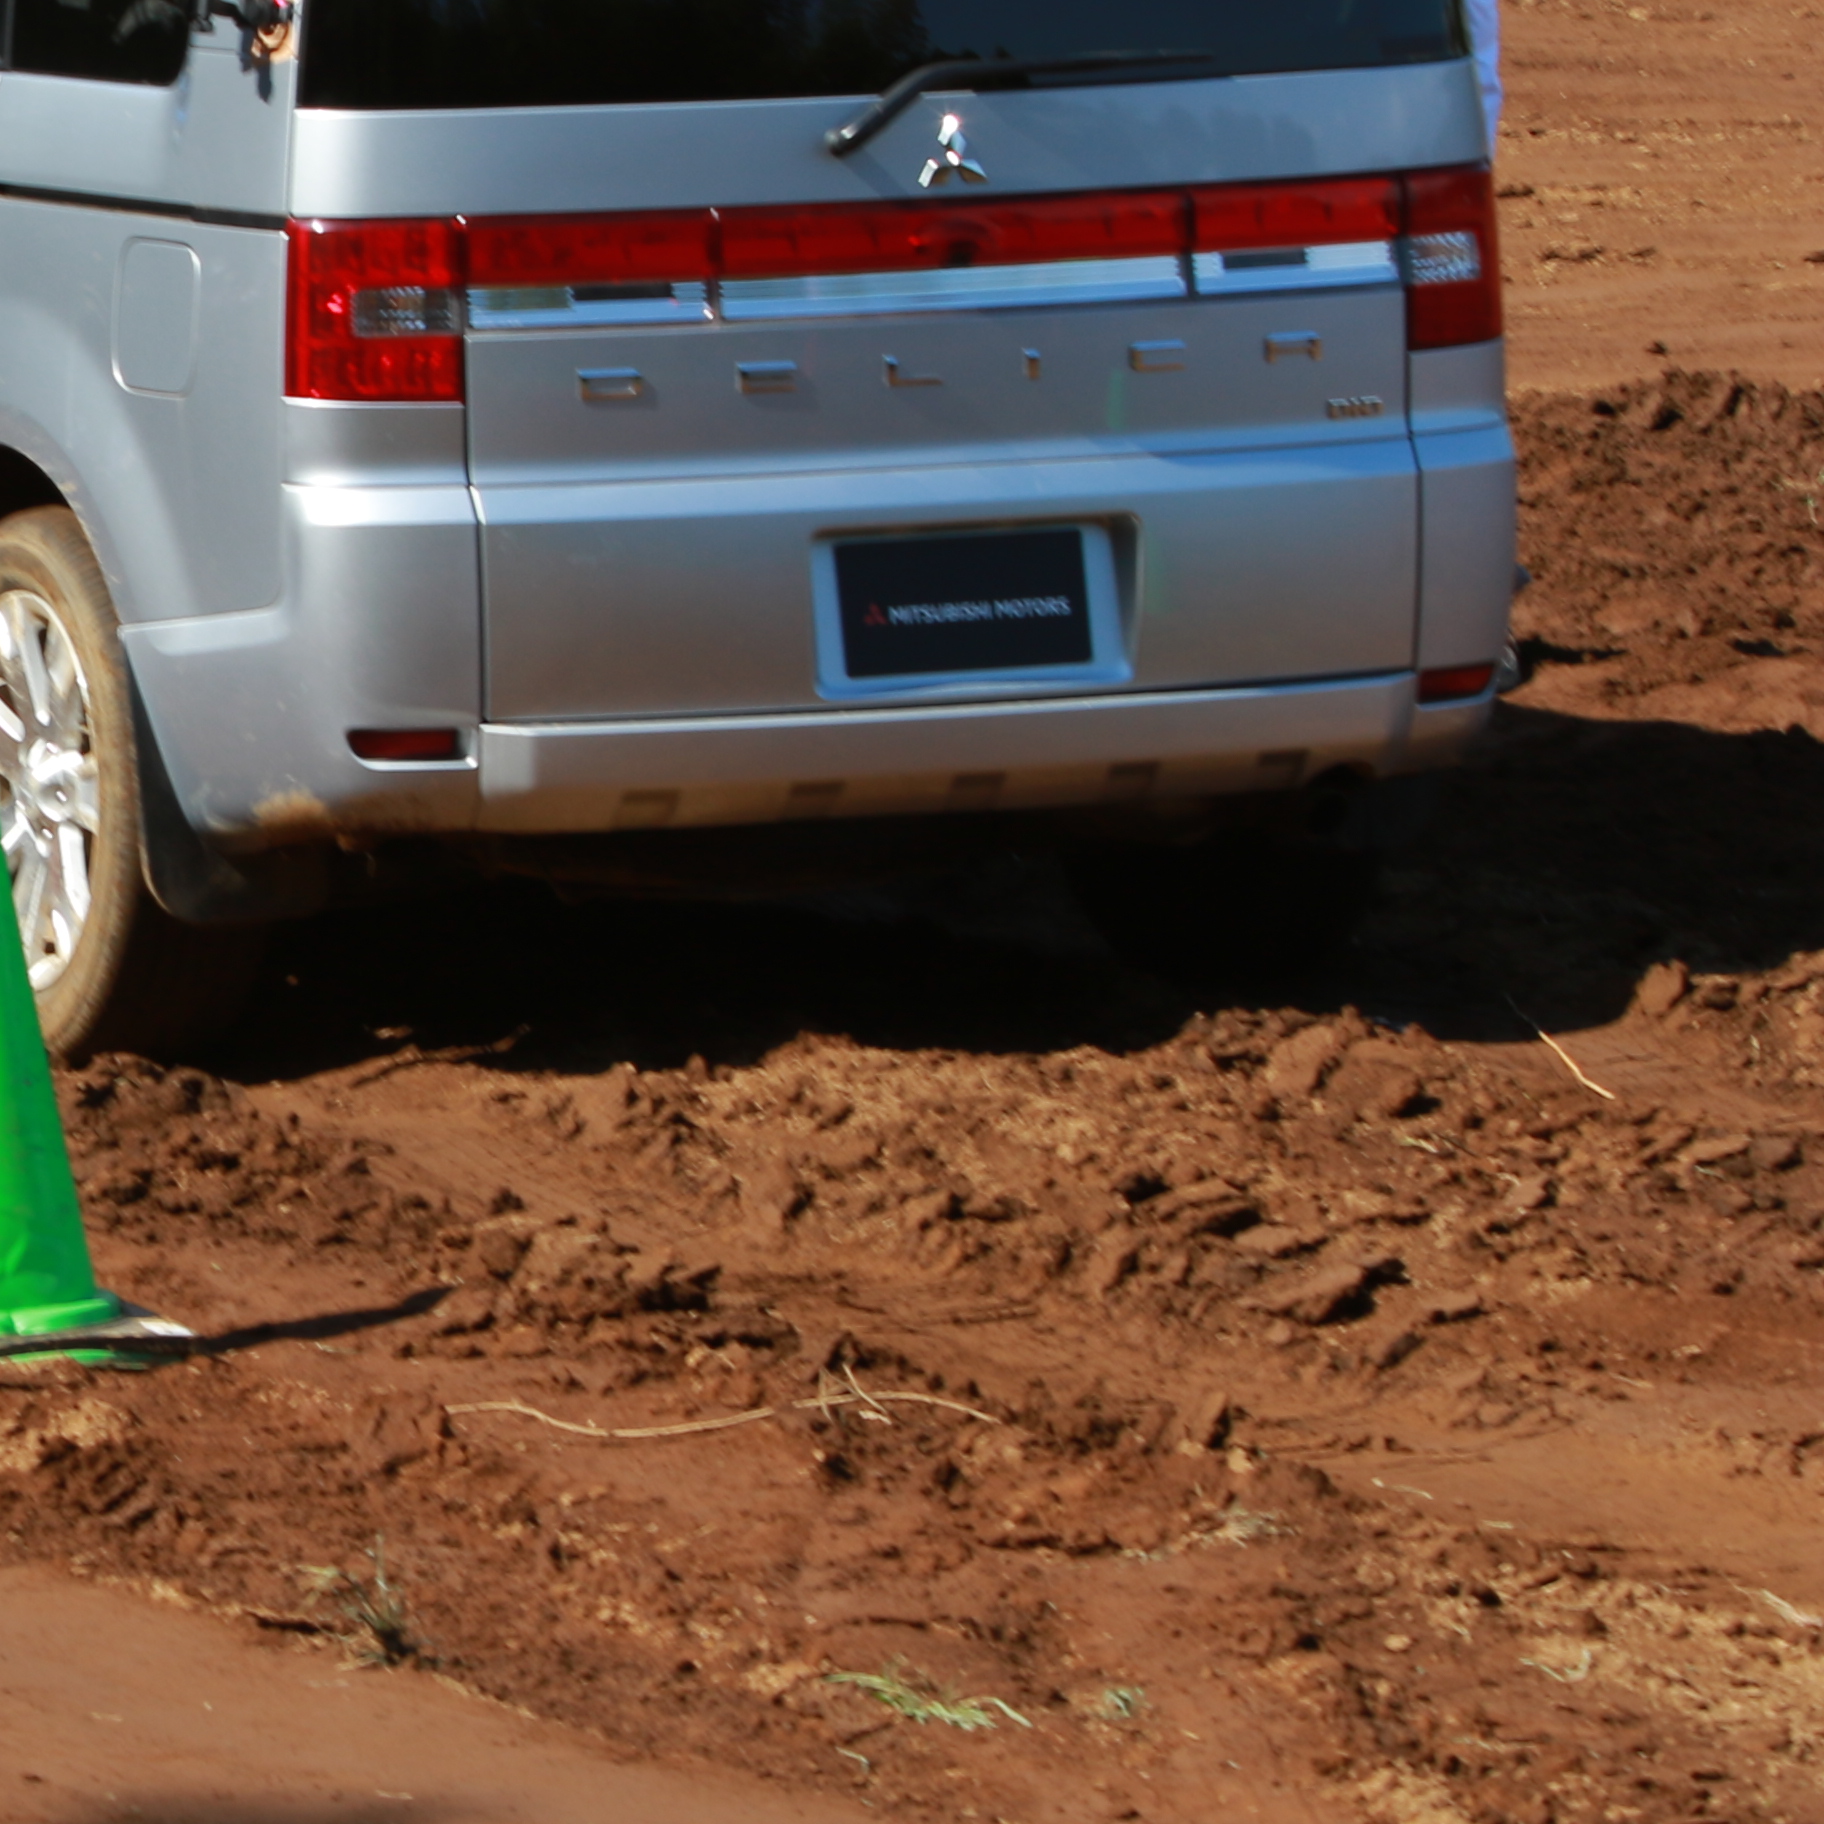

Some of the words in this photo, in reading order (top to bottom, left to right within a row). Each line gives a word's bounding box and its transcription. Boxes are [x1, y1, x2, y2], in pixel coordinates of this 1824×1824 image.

[574, 330, 1324, 401] DELICA
[887, 600, 995, 626] MITSUBISHI
[993, 594, 1073, 620] MOTORS
